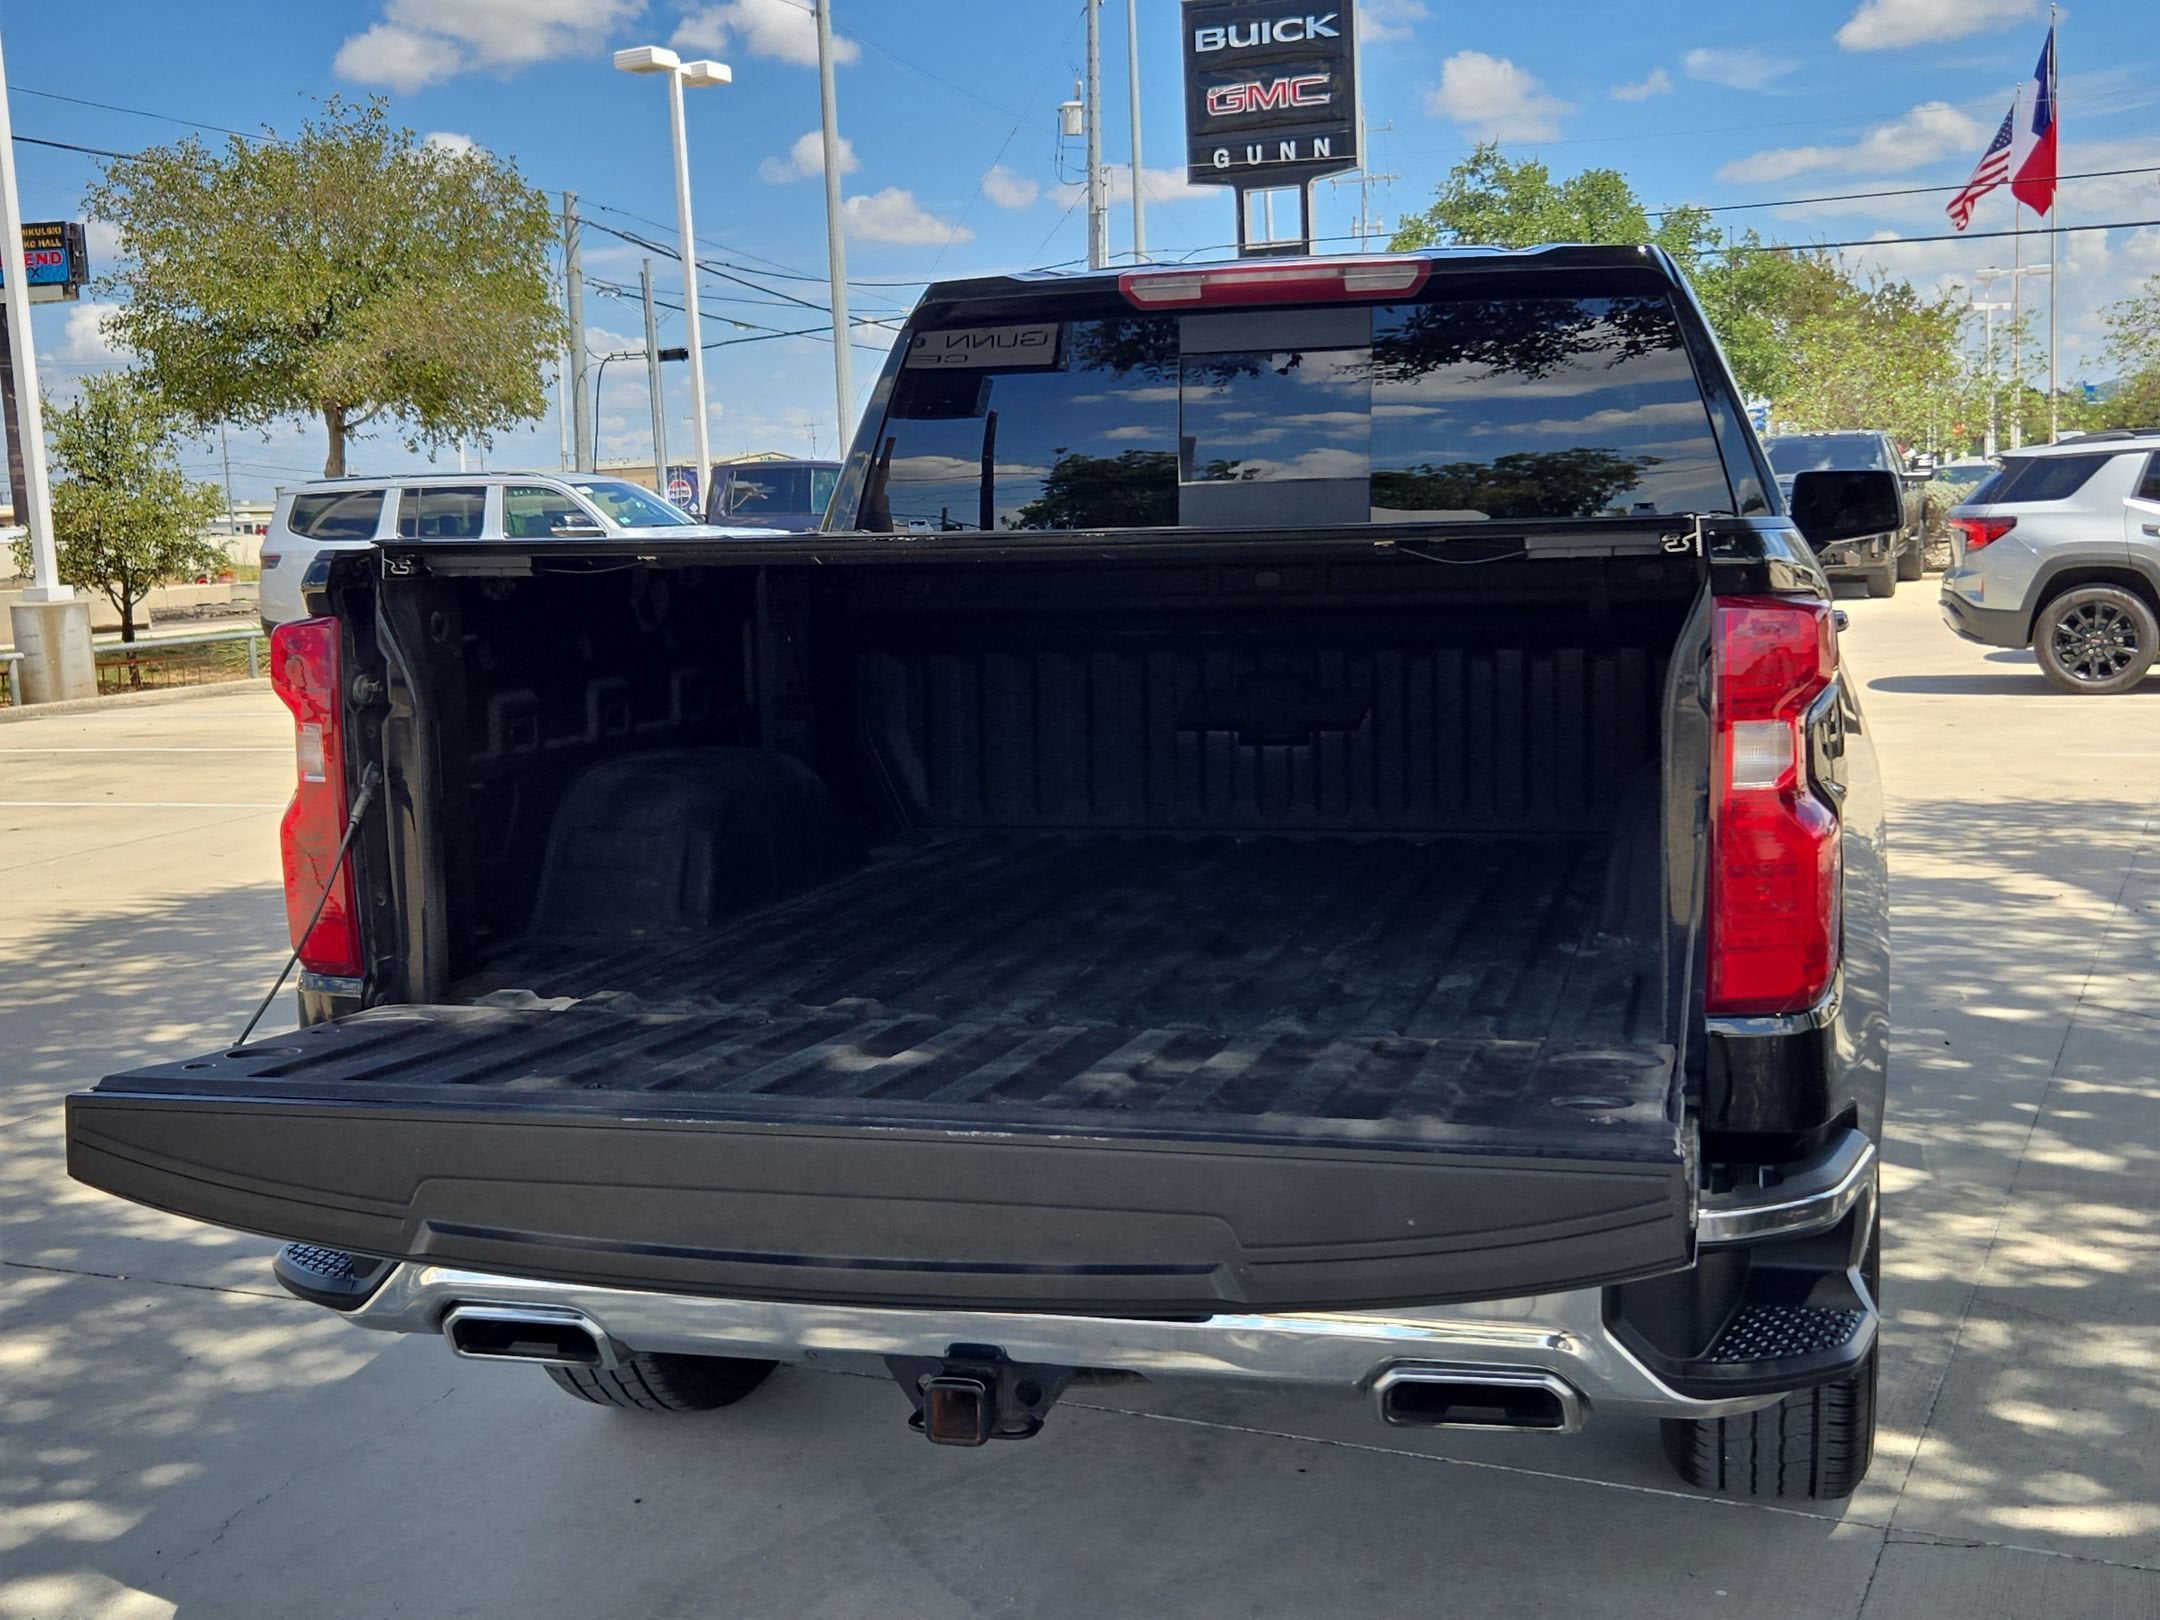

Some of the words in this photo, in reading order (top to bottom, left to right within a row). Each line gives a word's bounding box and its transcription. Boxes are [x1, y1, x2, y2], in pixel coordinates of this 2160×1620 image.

[1195, 14, 1340, 52] BUICK
[1207, 73, 1331, 116] GMC
[1213, 137, 1330, 168] GUNN
